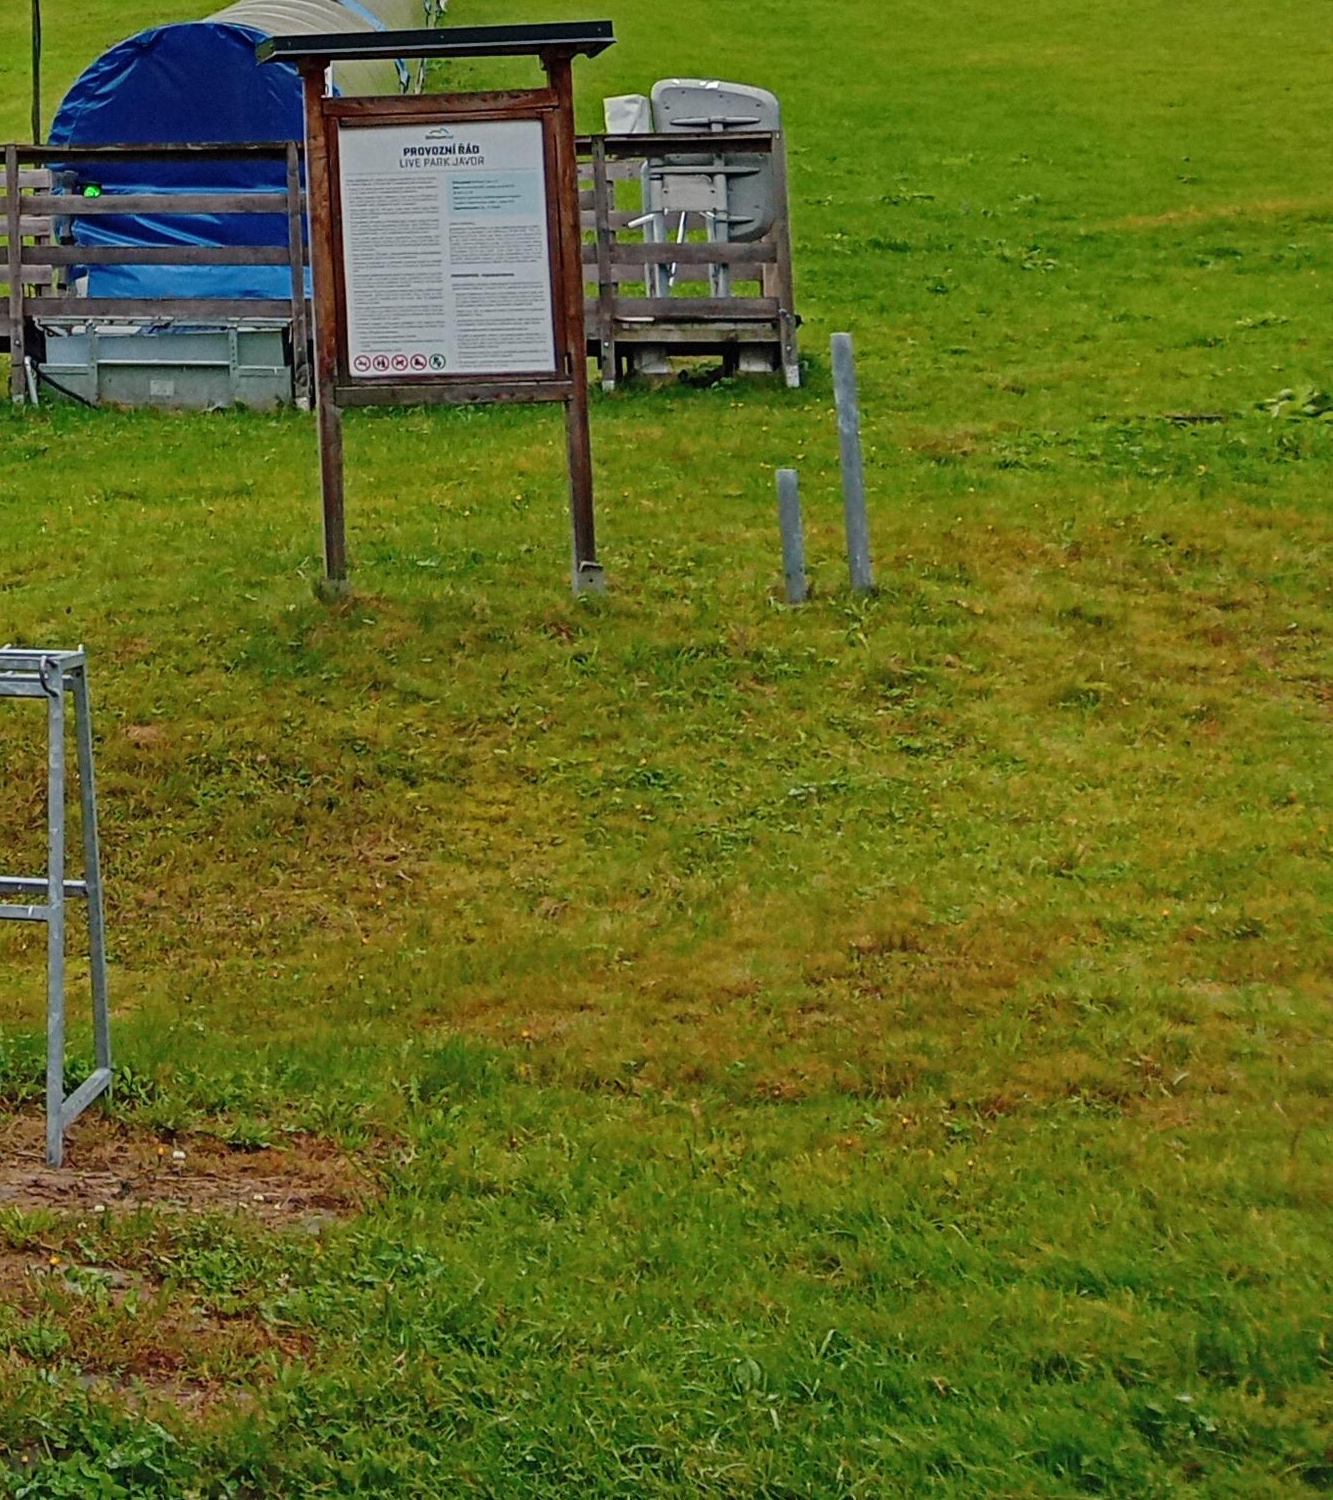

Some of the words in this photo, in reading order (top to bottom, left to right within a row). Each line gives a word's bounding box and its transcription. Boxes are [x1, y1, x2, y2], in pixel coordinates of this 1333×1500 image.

[403, 142, 456, 157] PROVOZNÍ
[458, 142, 480, 155] ŘÁD
[399, 157, 421, 168] LIVE
[423, 156, 450, 168] PARK
[452, 155, 485, 167] JAVOR
